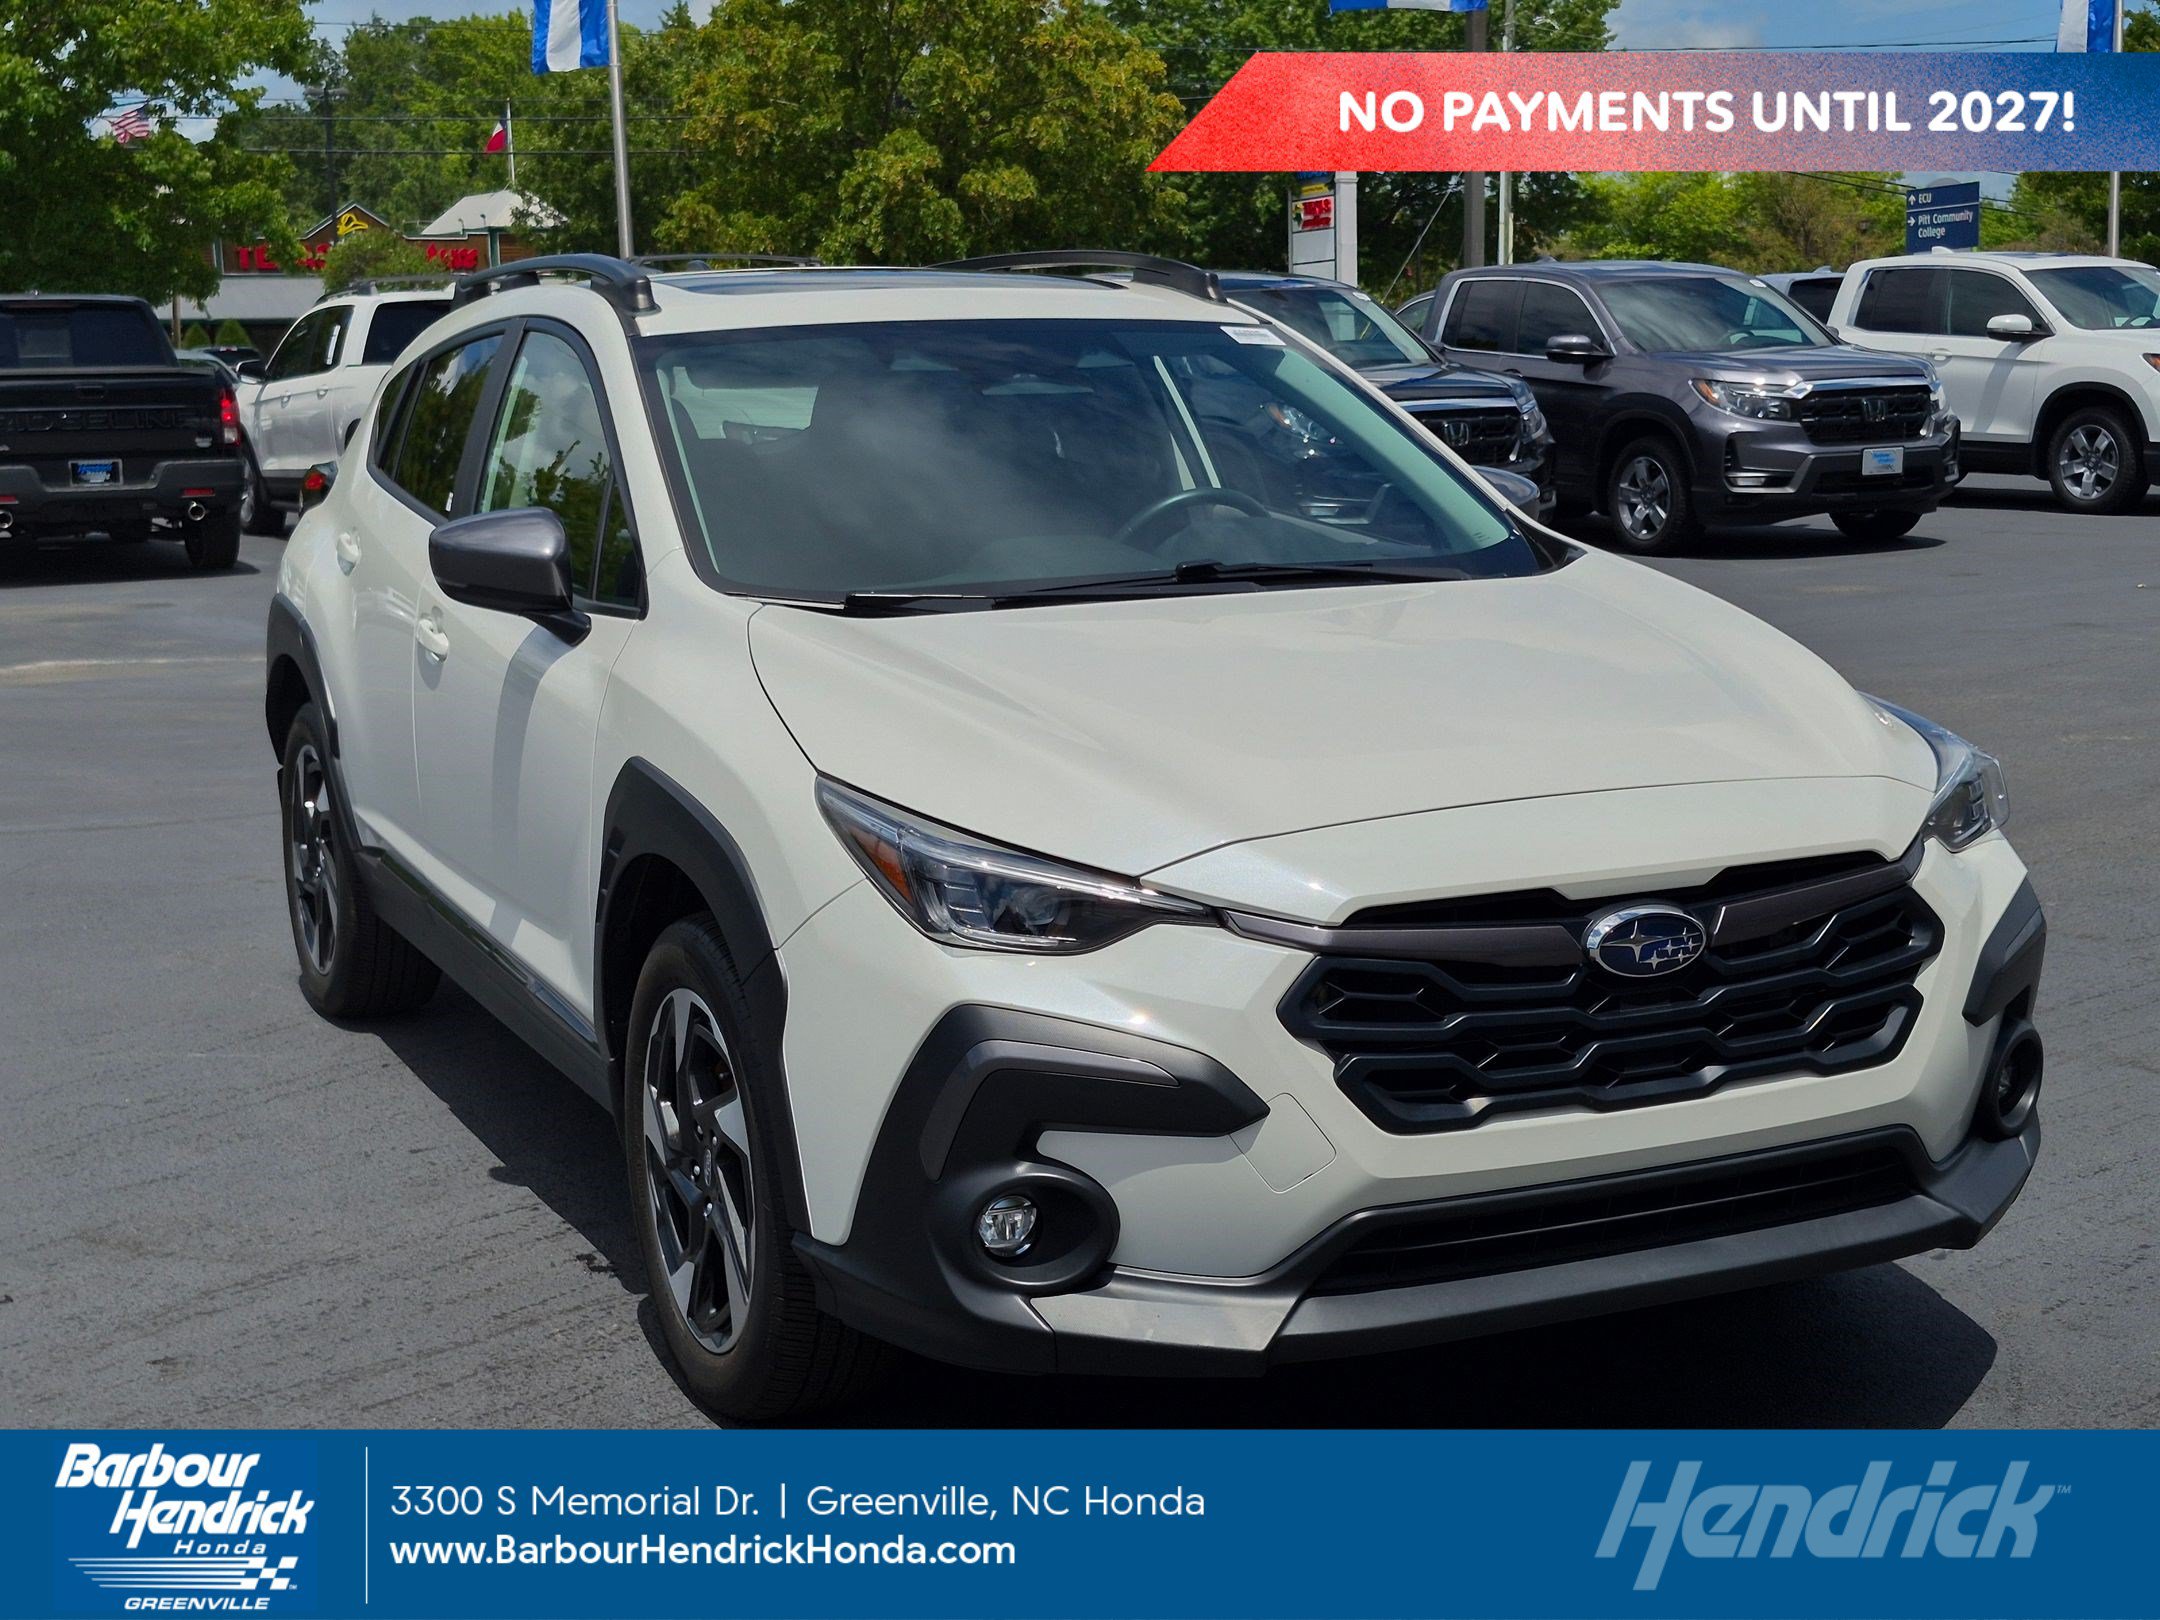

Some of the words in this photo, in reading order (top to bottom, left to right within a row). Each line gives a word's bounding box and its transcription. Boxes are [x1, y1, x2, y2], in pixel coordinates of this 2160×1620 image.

[1918, 193, 1932, 204] ECU
[1918, 213, 1931, 225] Pitt
[1932, 209, 1974, 223] Community
[1917, 226, 1946, 239] College
